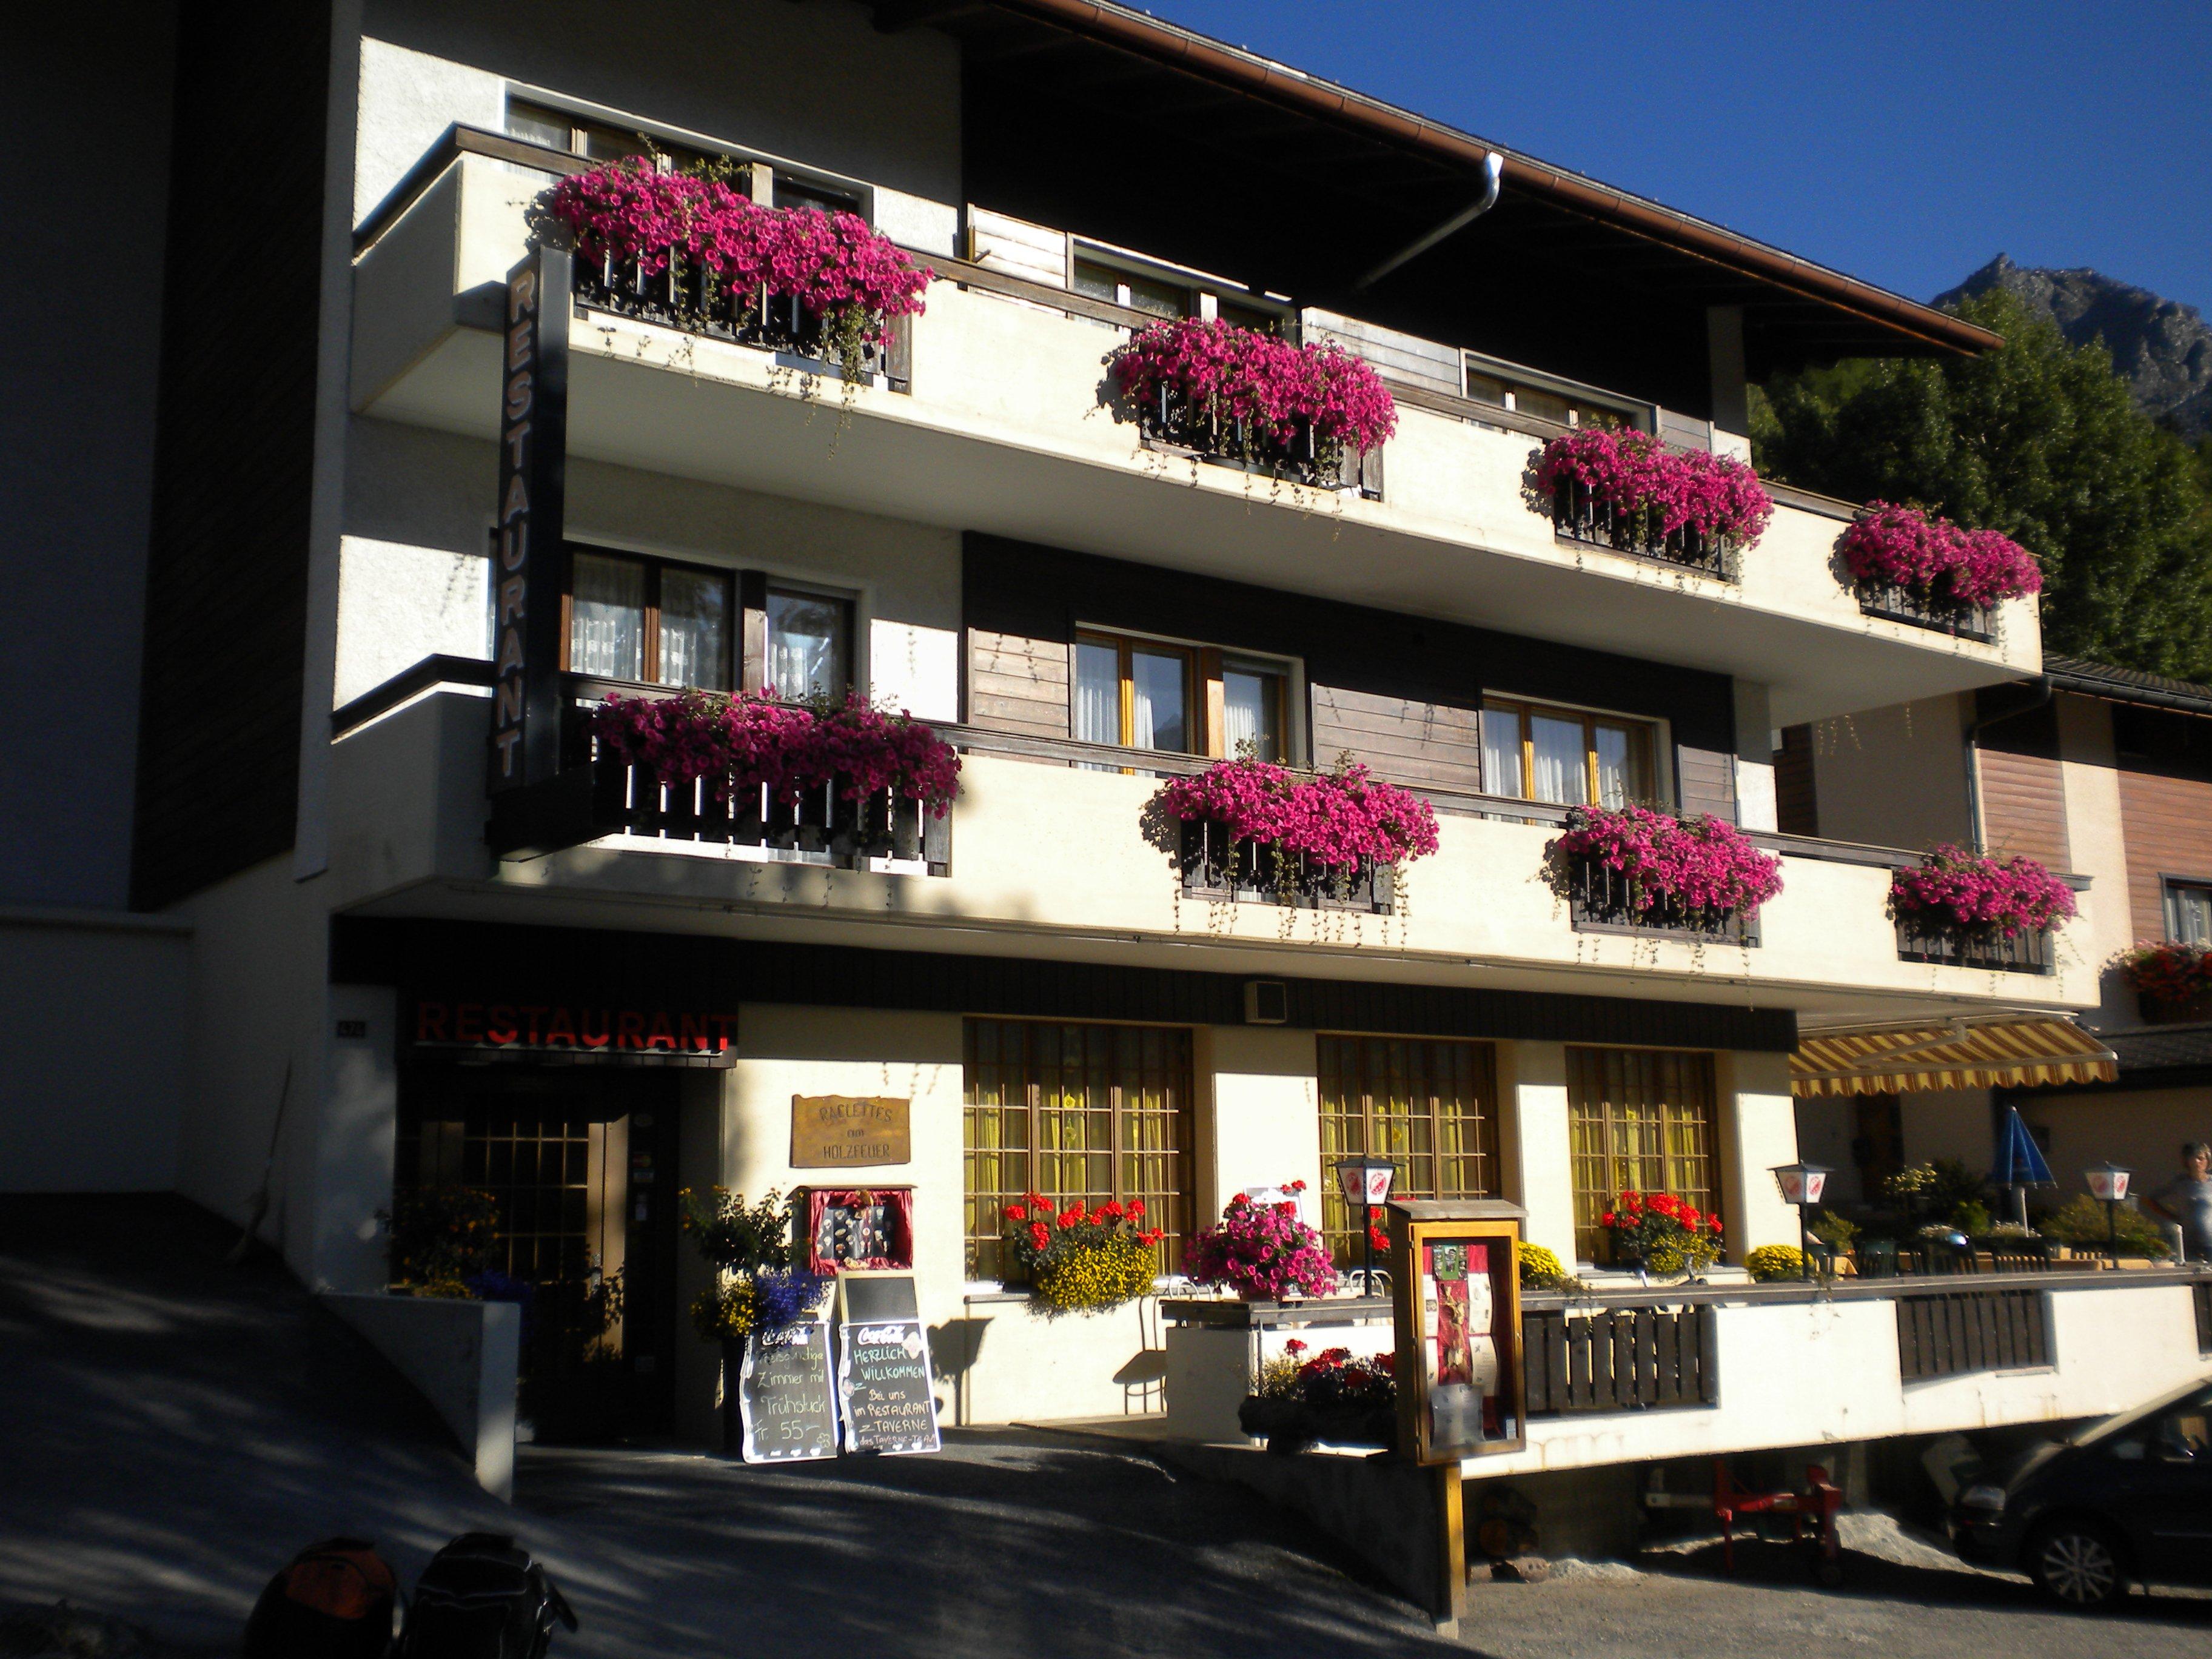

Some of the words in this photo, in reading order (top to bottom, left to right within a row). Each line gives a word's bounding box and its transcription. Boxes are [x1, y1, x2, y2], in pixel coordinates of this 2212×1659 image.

[497, 270, 535, 777] RESTAURANT
[417, 1002, 738, 1051] RESTAURANT
[819, 1102, 893, 1122] RACLETTES
[823, 1144, 891, 1160] HOLZFEUER
[853, 1346, 907, 1365] HERZLICH
[757, 1371, 803, 1388] Zimmer
[860, 1366, 925, 1381] WILLKOMMEN
[888, 1390, 906, 1401] uns
[853, 1406, 866, 1418] im
[867, 1400, 930, 1417] RESTAURANT
[874, 1419, 927, 1433] TAVERNE
